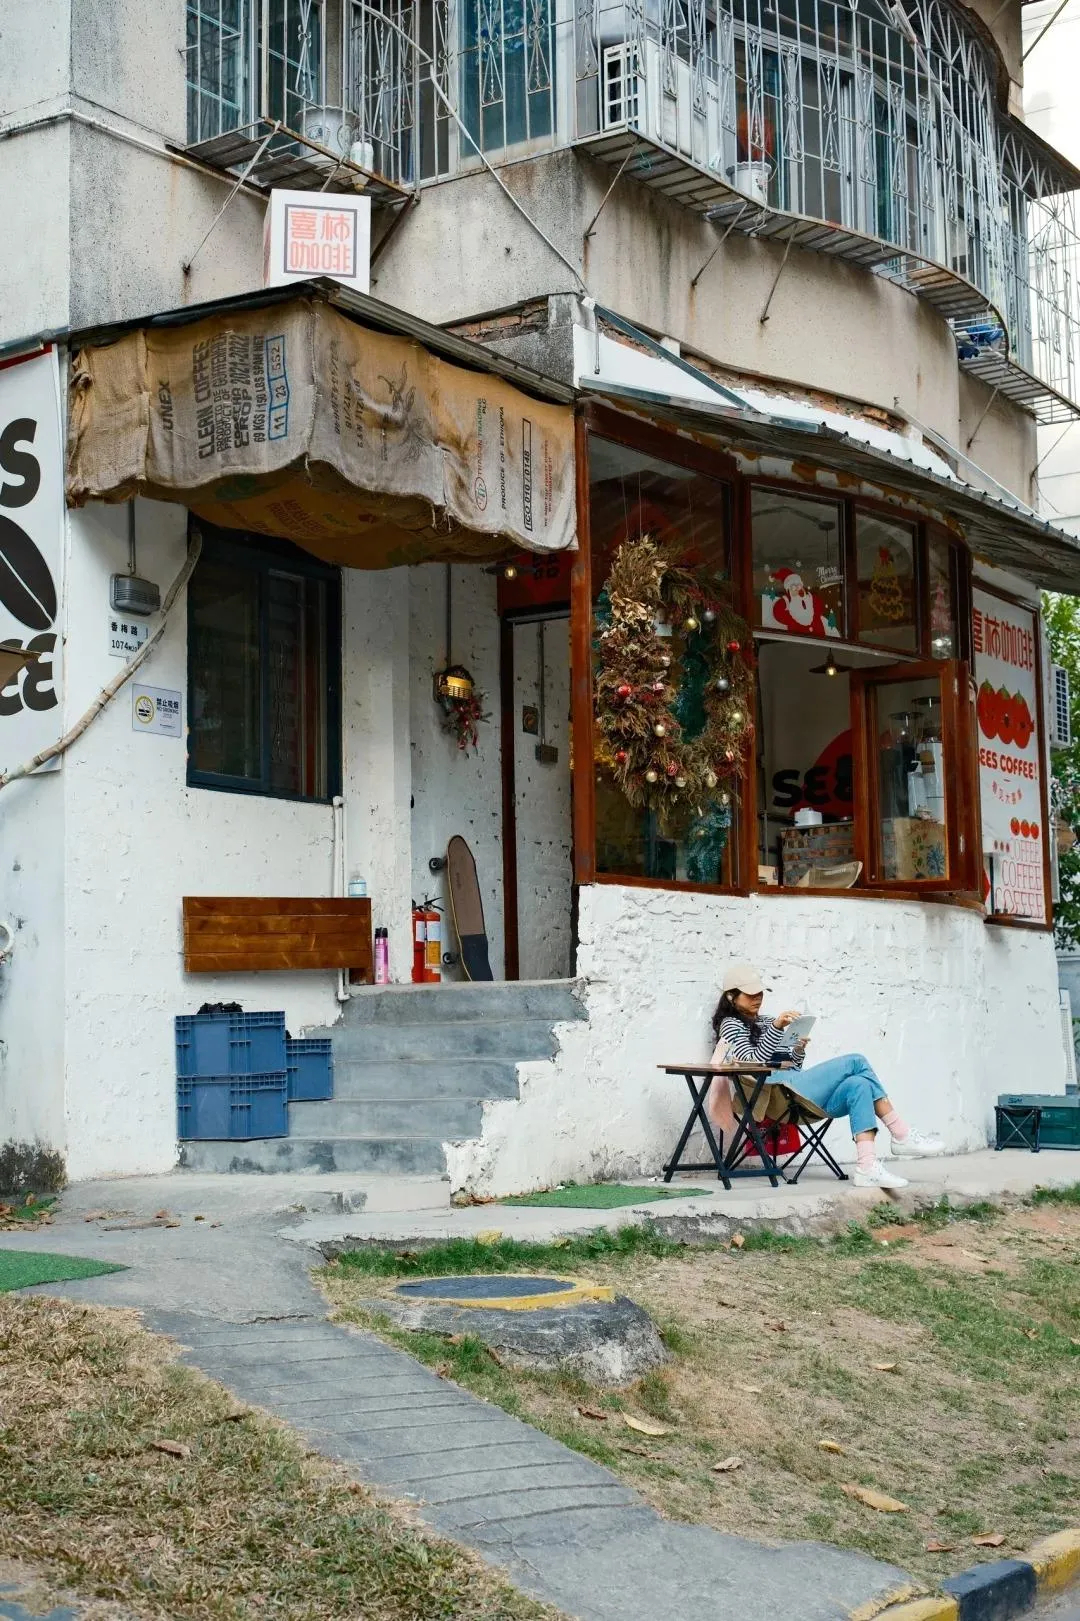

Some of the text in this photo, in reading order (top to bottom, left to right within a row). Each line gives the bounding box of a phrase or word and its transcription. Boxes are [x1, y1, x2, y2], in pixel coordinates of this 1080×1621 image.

[290, 241, 351, 273] 咖啡
[222, 388, 231, 400] OF
[253, 377, 265, 392] LBS
[275, 384, 286, 399] 23
[159, 380, 174, 431] UNEX
[240, 388, 252, 447] CROP
[253, 413, 266, 431] KGS
[273, 415, 285, 431] 11
[197, 404, 215, 459] CLEAN
[253, 432, 266, 443] 69
[500, 448, 505, 463] OF
[524, 506, 532, 527] ICO
[977, 748, 1038, 780] EES COFFEE!
[1002, 859, 1042, 891] COFFEE
